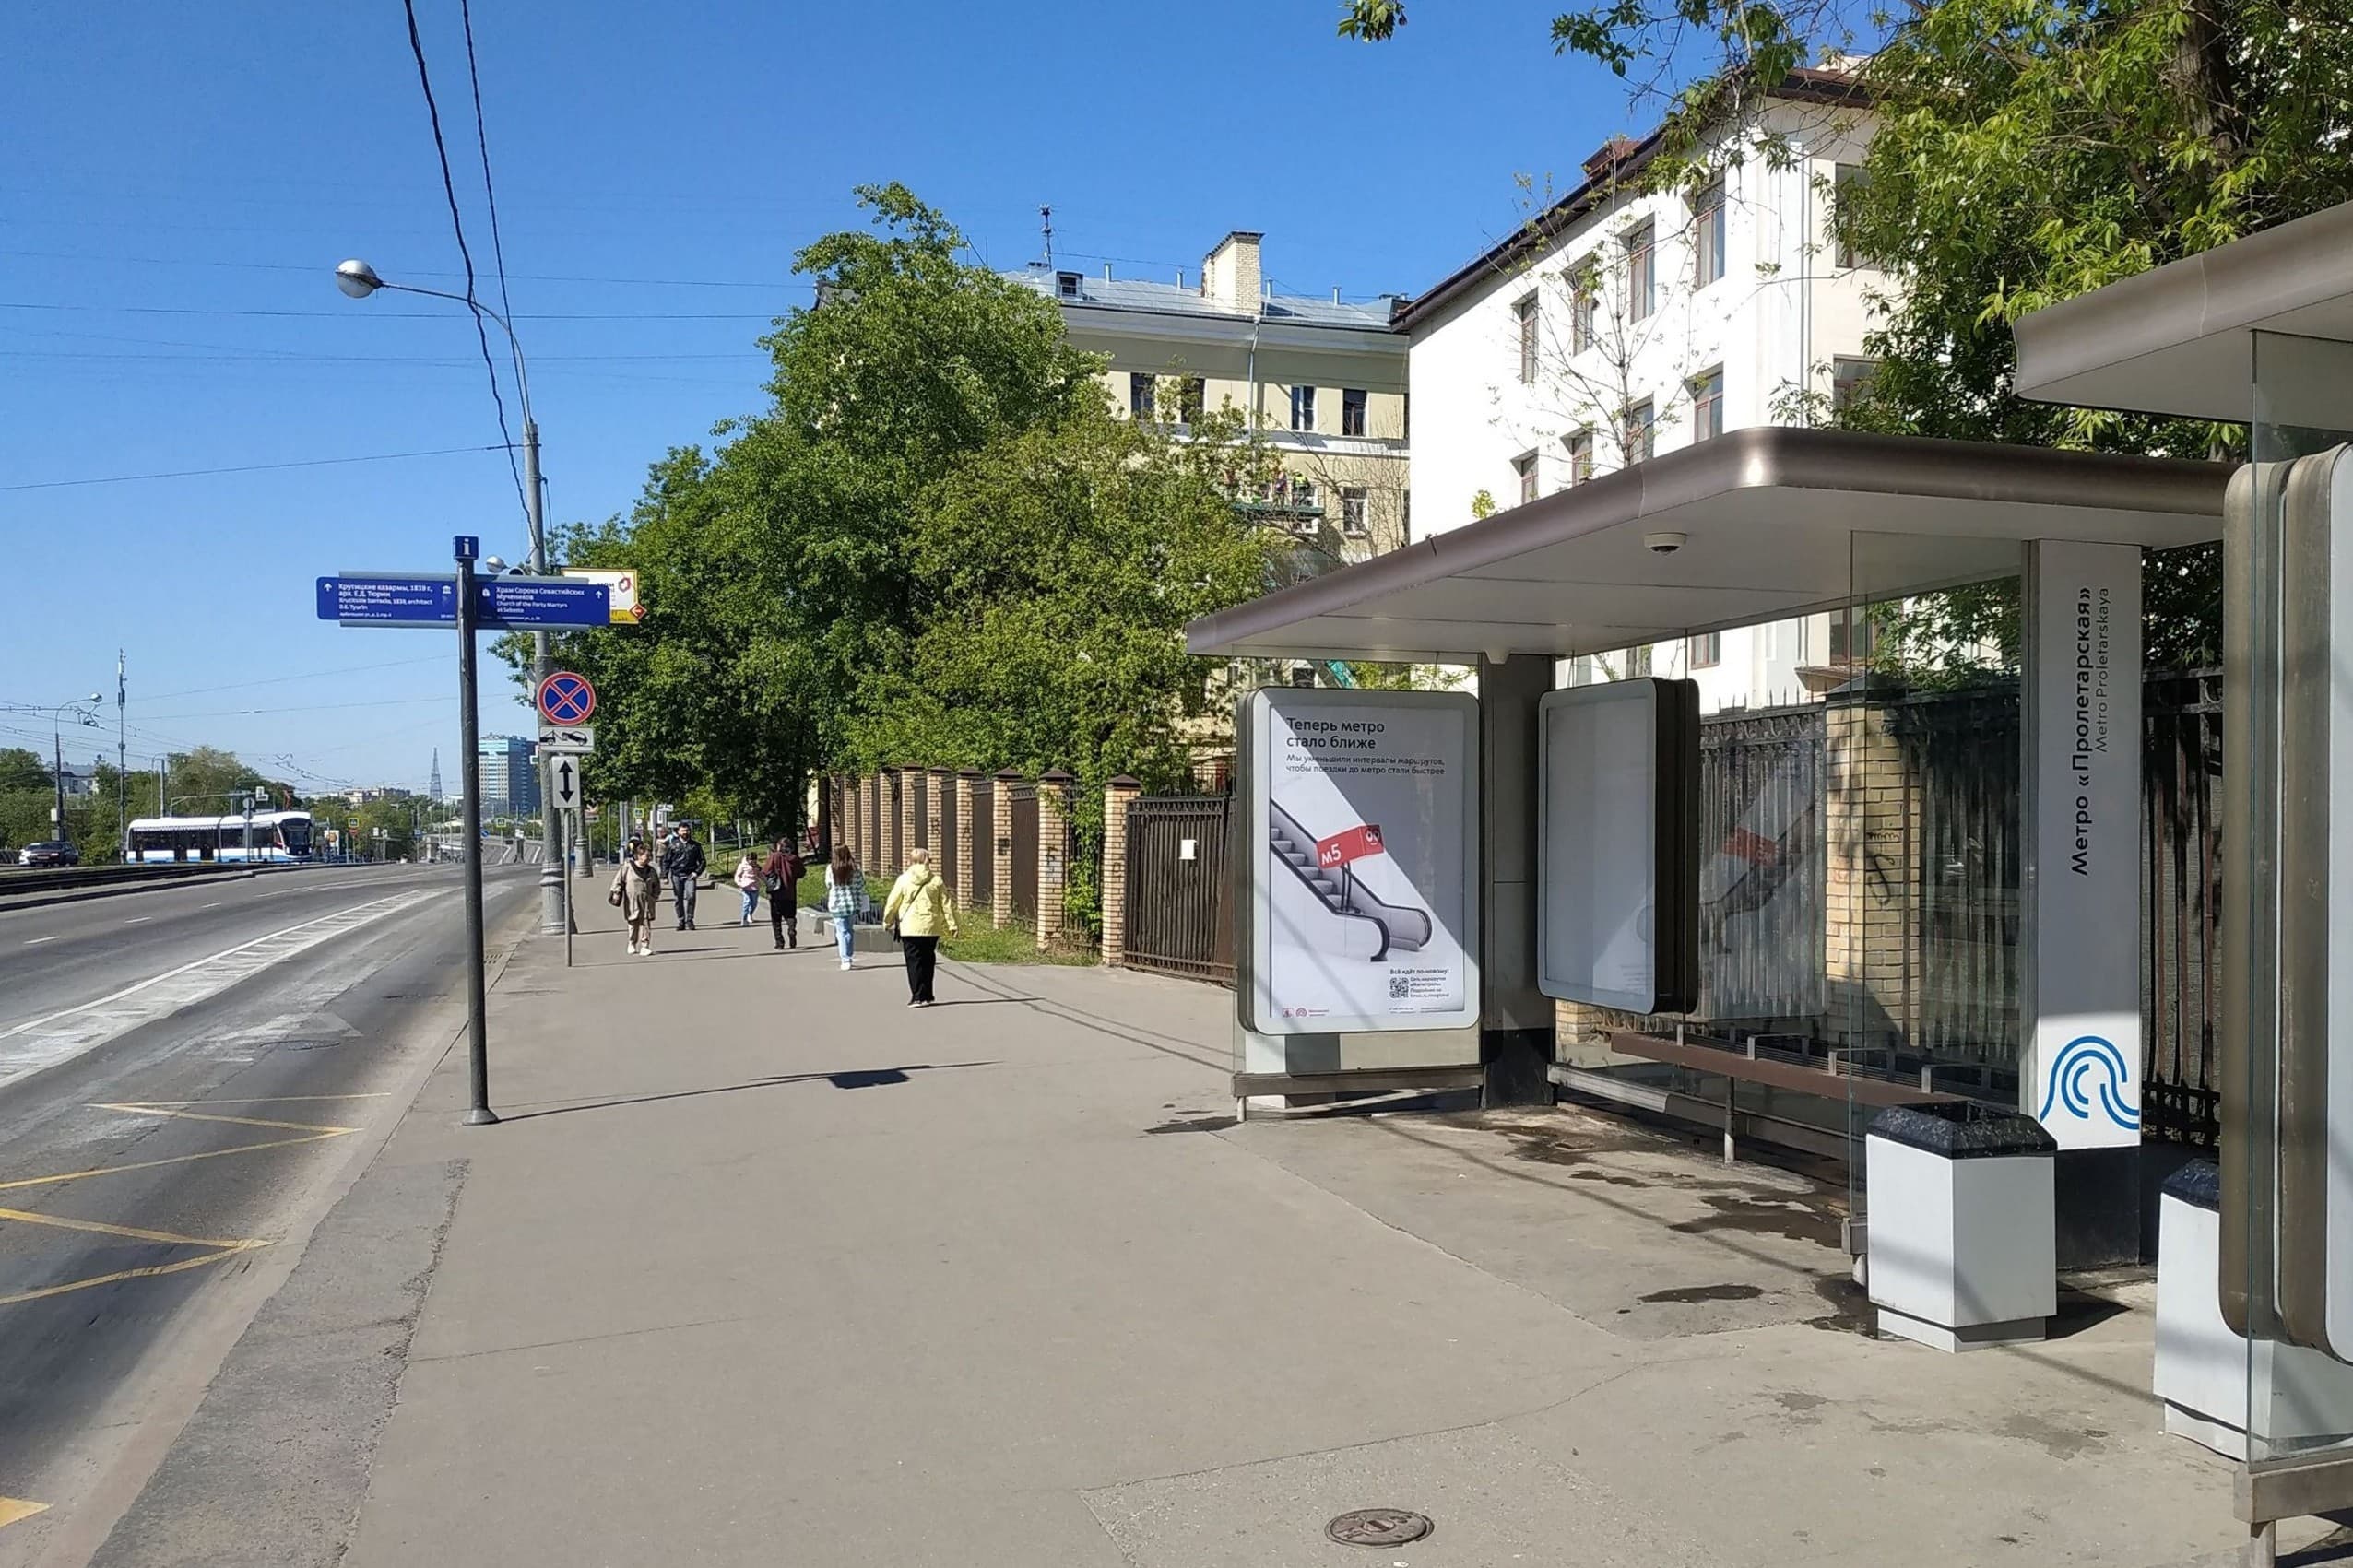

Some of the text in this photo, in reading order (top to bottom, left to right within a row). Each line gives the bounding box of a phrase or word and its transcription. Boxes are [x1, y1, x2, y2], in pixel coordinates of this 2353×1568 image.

[496, 586, 514, 595] Храм
[514, 587, 538, 595] Сорока
[2096, 587, 2111, 753] Metro Proletarskaya
[1286, 717, 1385, 735] Теперь метро
[2071, 587, 2093, 876] Метро «Пролетарская»
[1286, 735, 1377, 749] стало ближе
[1286, 754, 1302, 762] Мы
[1304, 756, 1351, 764] уменьшили
[1353, 757, 1396, 765] интервалы
[1286, 763, 1311, 772] чтобы
[1411, 765, 1445, 774] быстрее
